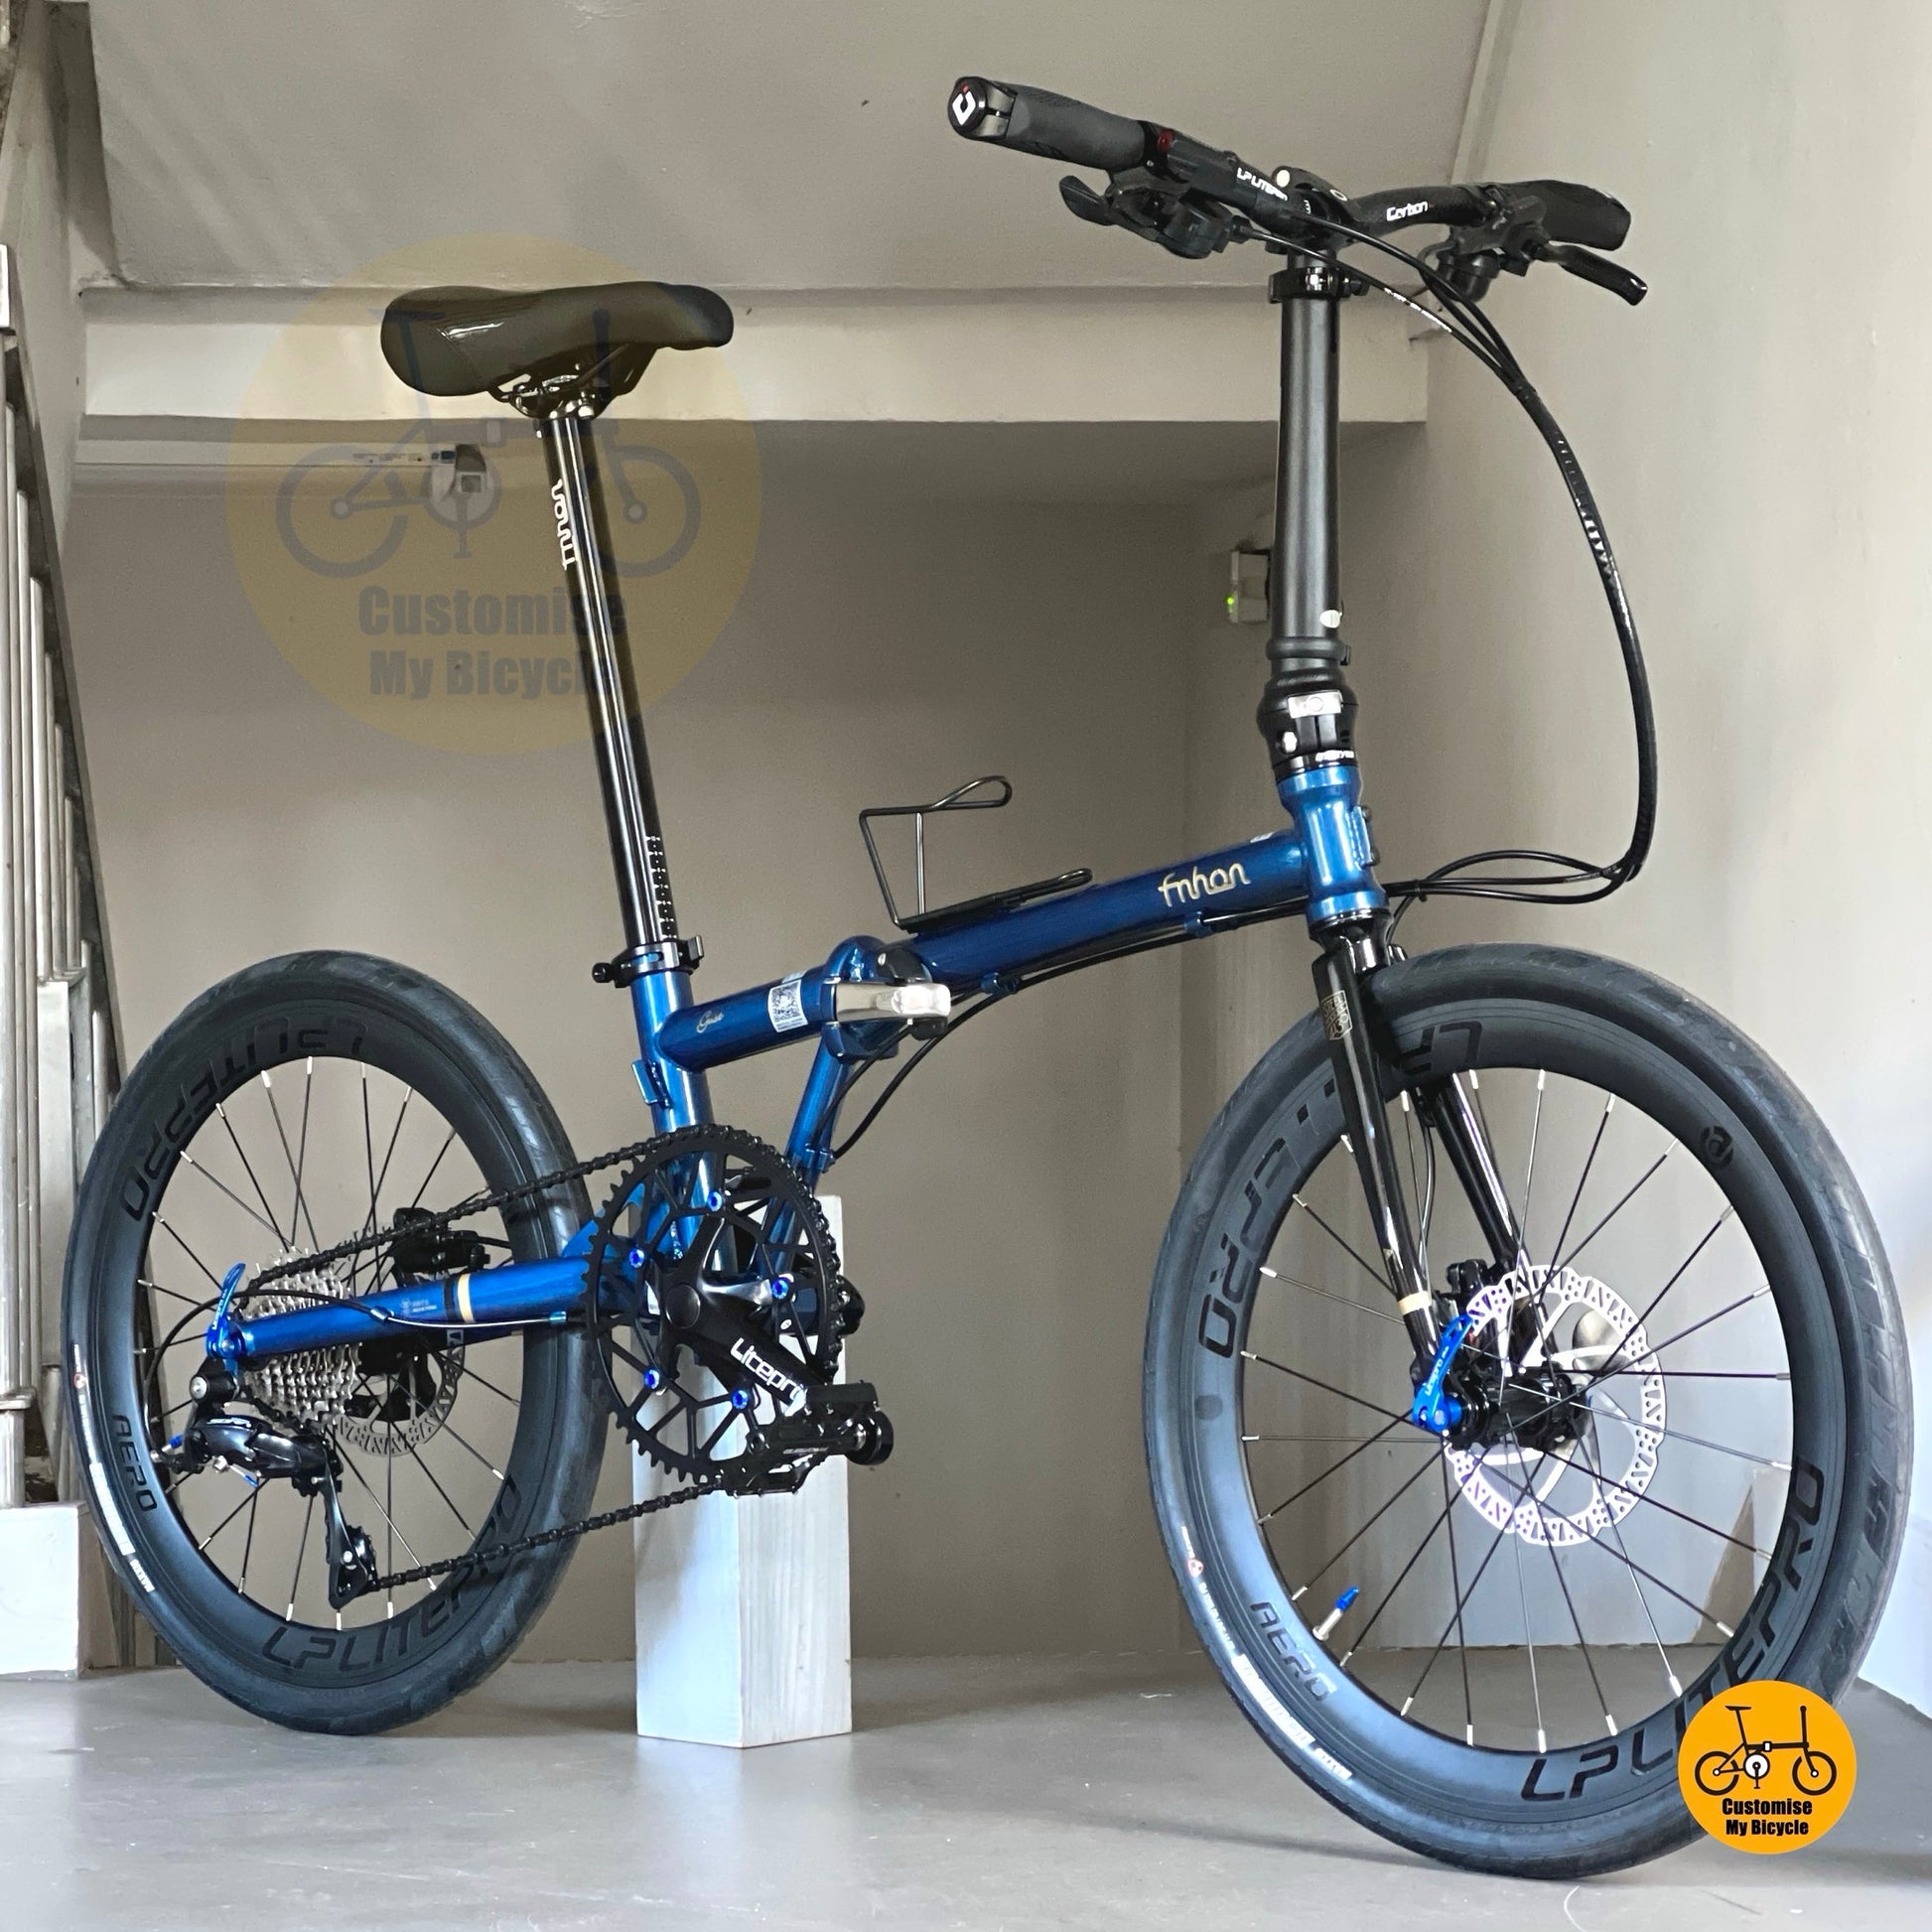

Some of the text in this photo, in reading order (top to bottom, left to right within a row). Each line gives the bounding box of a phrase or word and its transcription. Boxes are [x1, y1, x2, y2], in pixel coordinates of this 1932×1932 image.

[1158, 863, 1251, 908] fnhon
[1197, 1020, 1483, 1359] LPEPRO
[112, 1414, 158, 1512] AERO
[1250, 1601, 1337, 1702] AERO
